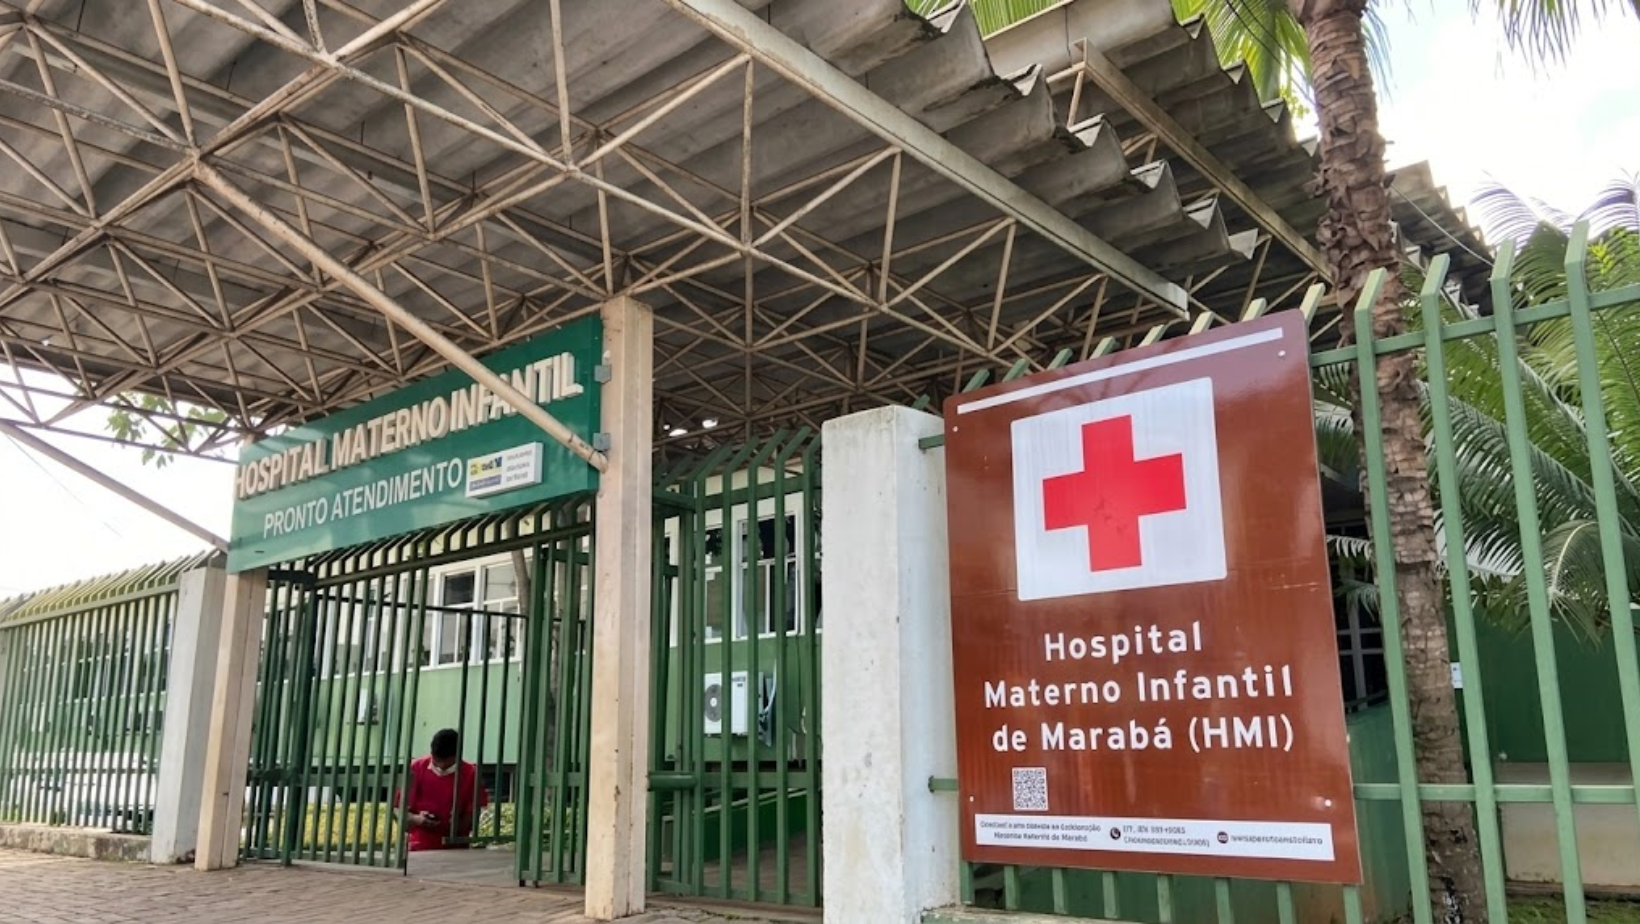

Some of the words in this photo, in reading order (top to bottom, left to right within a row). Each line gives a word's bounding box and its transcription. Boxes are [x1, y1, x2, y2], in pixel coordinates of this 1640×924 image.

[235, 438, 329, 500] HOSPITAL
[331, 396, 452, 470] MATERNO
[263, 497, 328, 539] PRONTO
[330, 457, 463, 521] ATENDIMENTO
[1044, 620, 1202, 664] Hospital
[984, 679, 1121, 708] Materno
[1137, 664, 1293, 701] Infantil
[992, 724, 1027, 751] de
[1041, 717, 1173, 750] Marabá
[1189, 713, 1293, 753] (HMI)
